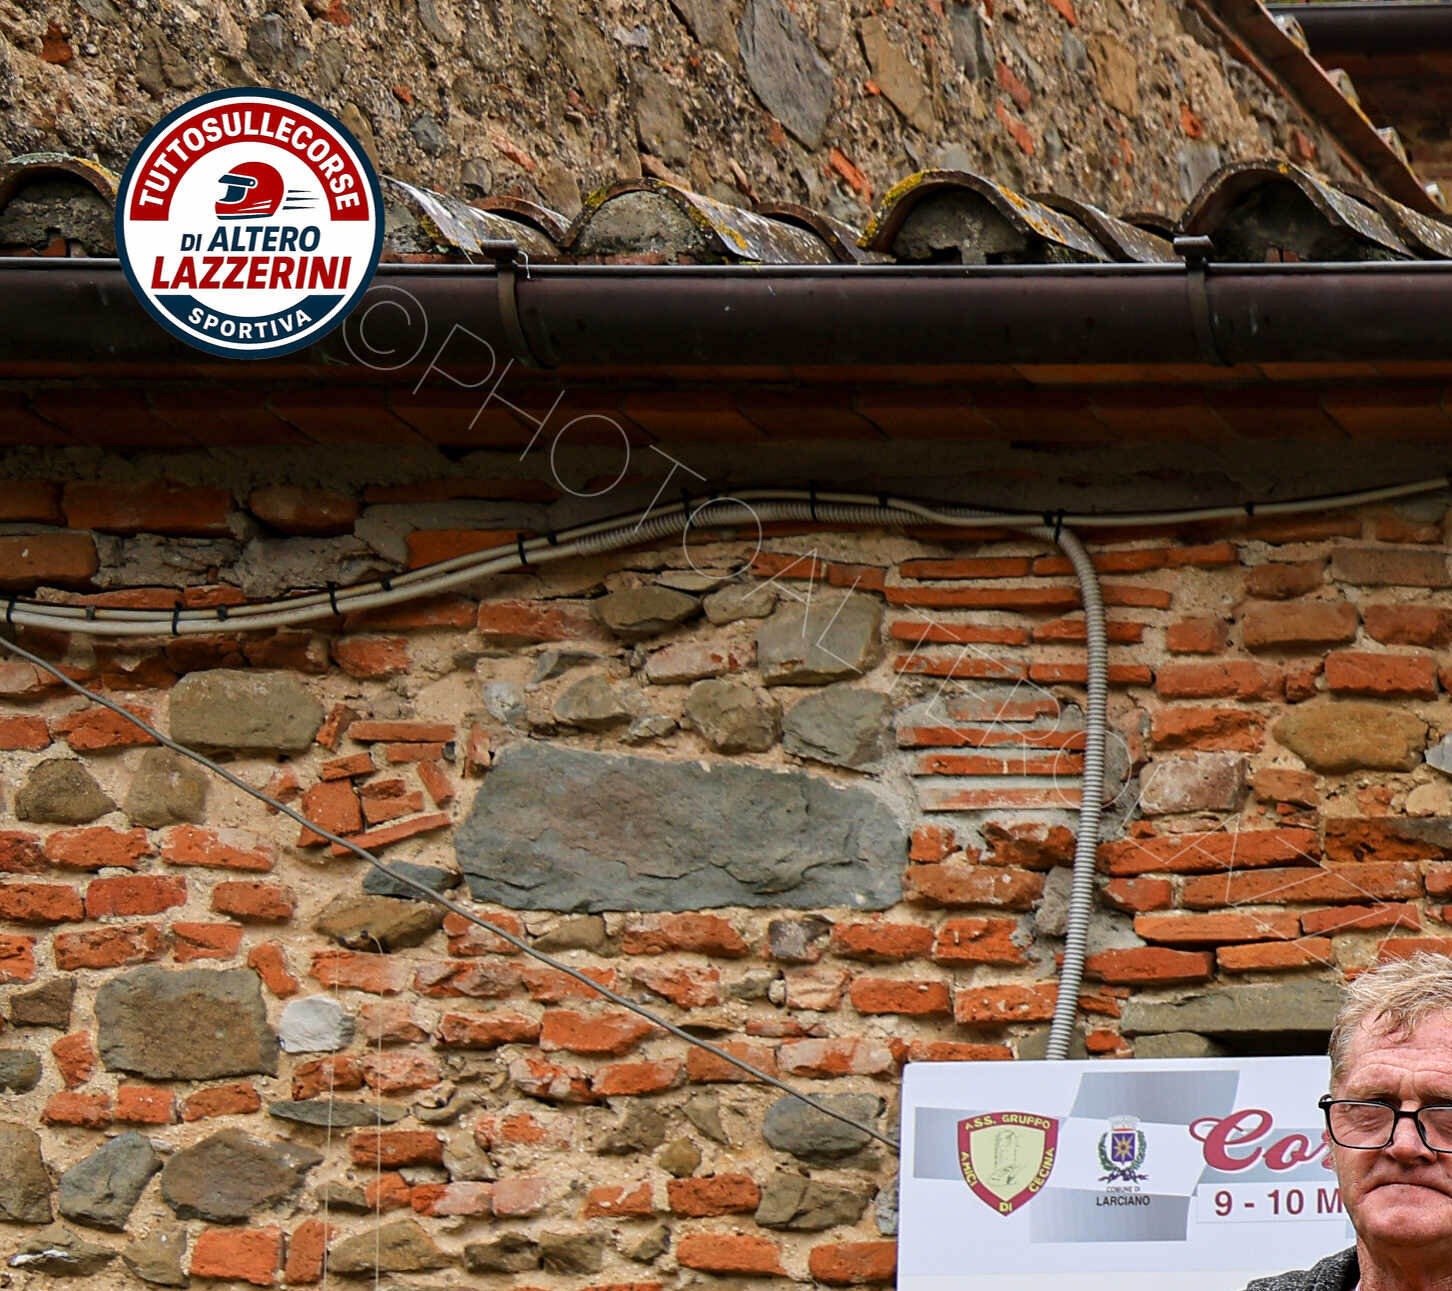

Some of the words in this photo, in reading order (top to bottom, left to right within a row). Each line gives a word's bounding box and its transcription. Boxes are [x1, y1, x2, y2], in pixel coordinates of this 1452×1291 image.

[965, 1116, 997, 1130] ASS.
[1002, 1114, 1051, 1129] GRUPPO
[961, 1152, 977, 1187] AMICI
[1000, 1202, 1012, 1212] DI
[1029, 1148, 1054, 1192] CECINA
[1096, 1195, 1150, 1206] LARCIANO
[1214, 1191, 1232, 1216] 9
[1268, 1189, 1302, 1215] 10
